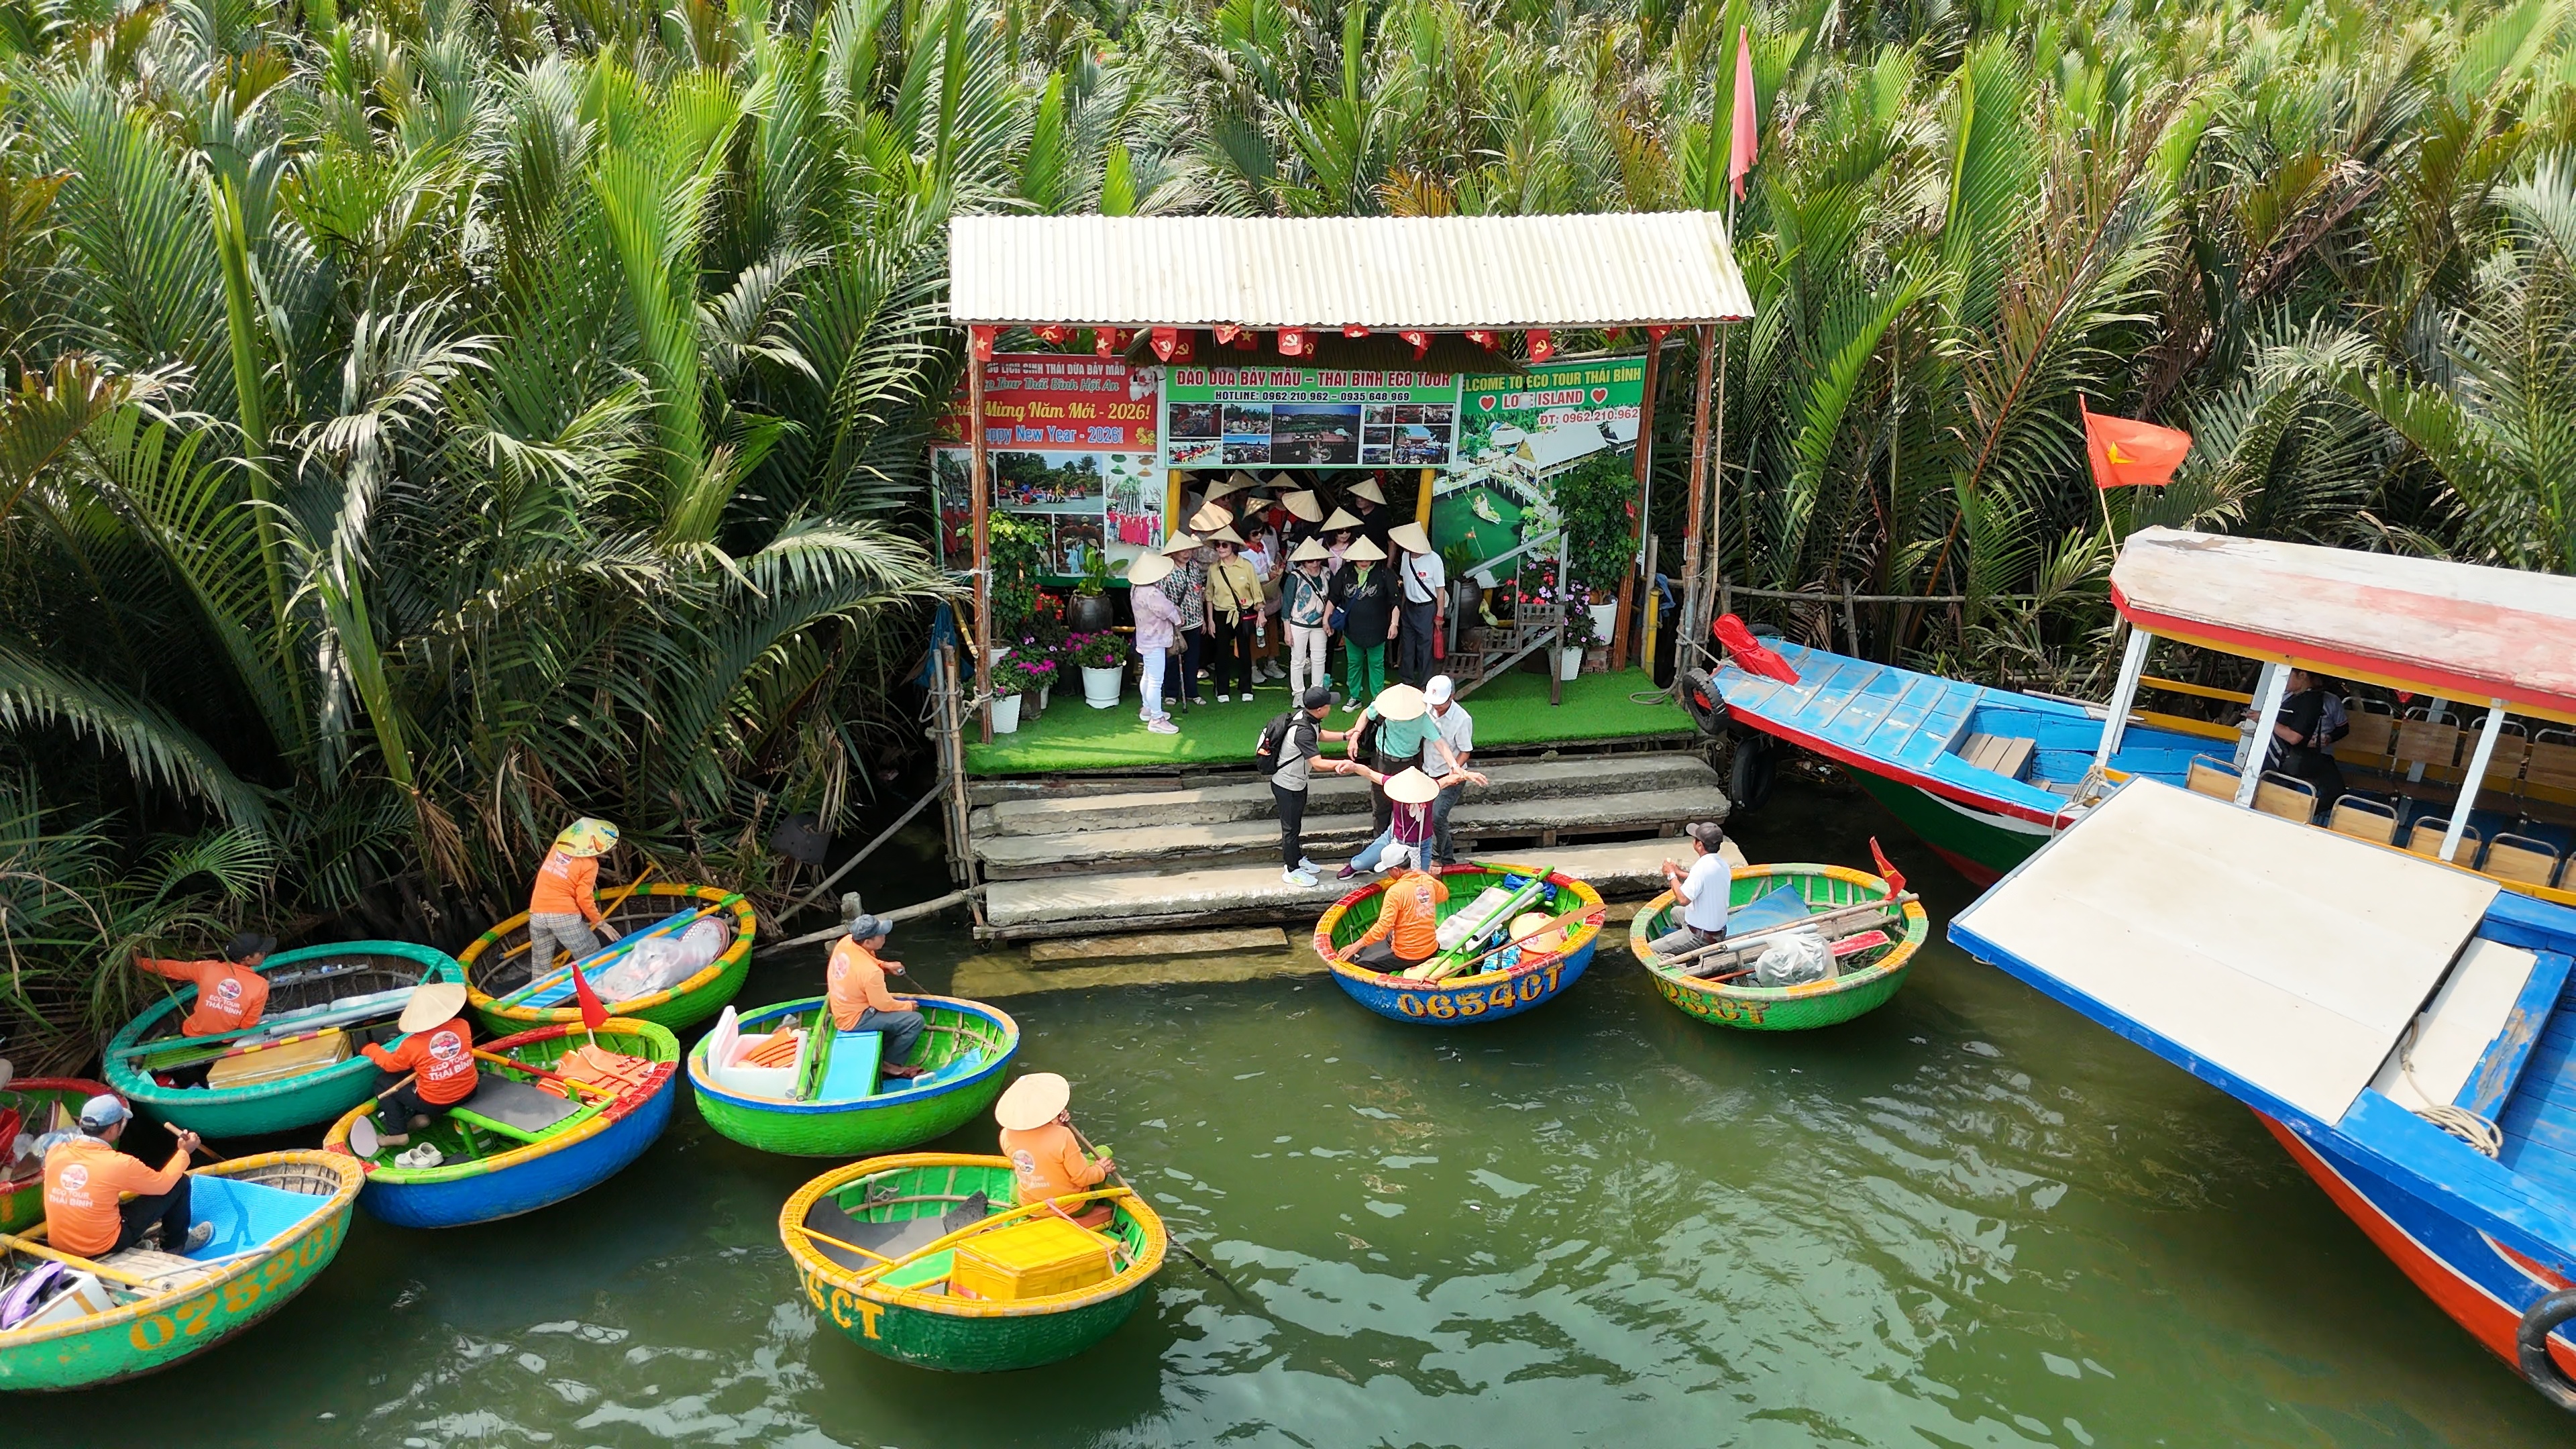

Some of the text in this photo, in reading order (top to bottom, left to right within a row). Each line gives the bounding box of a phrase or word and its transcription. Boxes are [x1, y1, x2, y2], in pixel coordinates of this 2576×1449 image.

[1046, 362, 1065, 374] THÁI
[1087, 362, 1104, 375] BẢY
[1106, 361, 1126, 376] MẪU
[1240, 368, 1267, 386] BẢY
[1387, 371, 1413, 387] ECO
[1080, 378, 1101, 393] Hội
[1101, 379, 1120, 391] An
[1463, 366, 1642, 392] LCOME TO ECO TOUR THÁI BÌNH
[1215, 390, 1260, 401] HOTLINE:
[1262, 391, 1288, 401] 0962
[1290, 392, 1307, 401] 210
[1309, 392, 1328, 401] 962
[1340, 392, 1366, 401] 0935
[1369, 392, 1388, 401] 648
[1391, 392, 1410, 401] 969
[1503, 390, 1583, 409] LO ISLAND
[1028, 401, 1065, 418] Năm
[1068, 402, 1097, 419] Mới
[1108, 402, 1151, 421] 2026!
[1562, 409, 1639, 423] 0962.210.962
[985, 428, 1012, 445] ppy
[1016, 425, 1043, 442] New
[1046, 425, 1077, 443] Year
[1087, 426, 1124, 444] 2026!
[1397, 961, 1566, 1019] 0654CT
[223, 999, 240, 1008] TOUR
[430, 1051, 470, 1071] ECO TOUR
[68, 1190, 90, 1199] TOUR
[796, 1265, 885, 1340] 6CT
